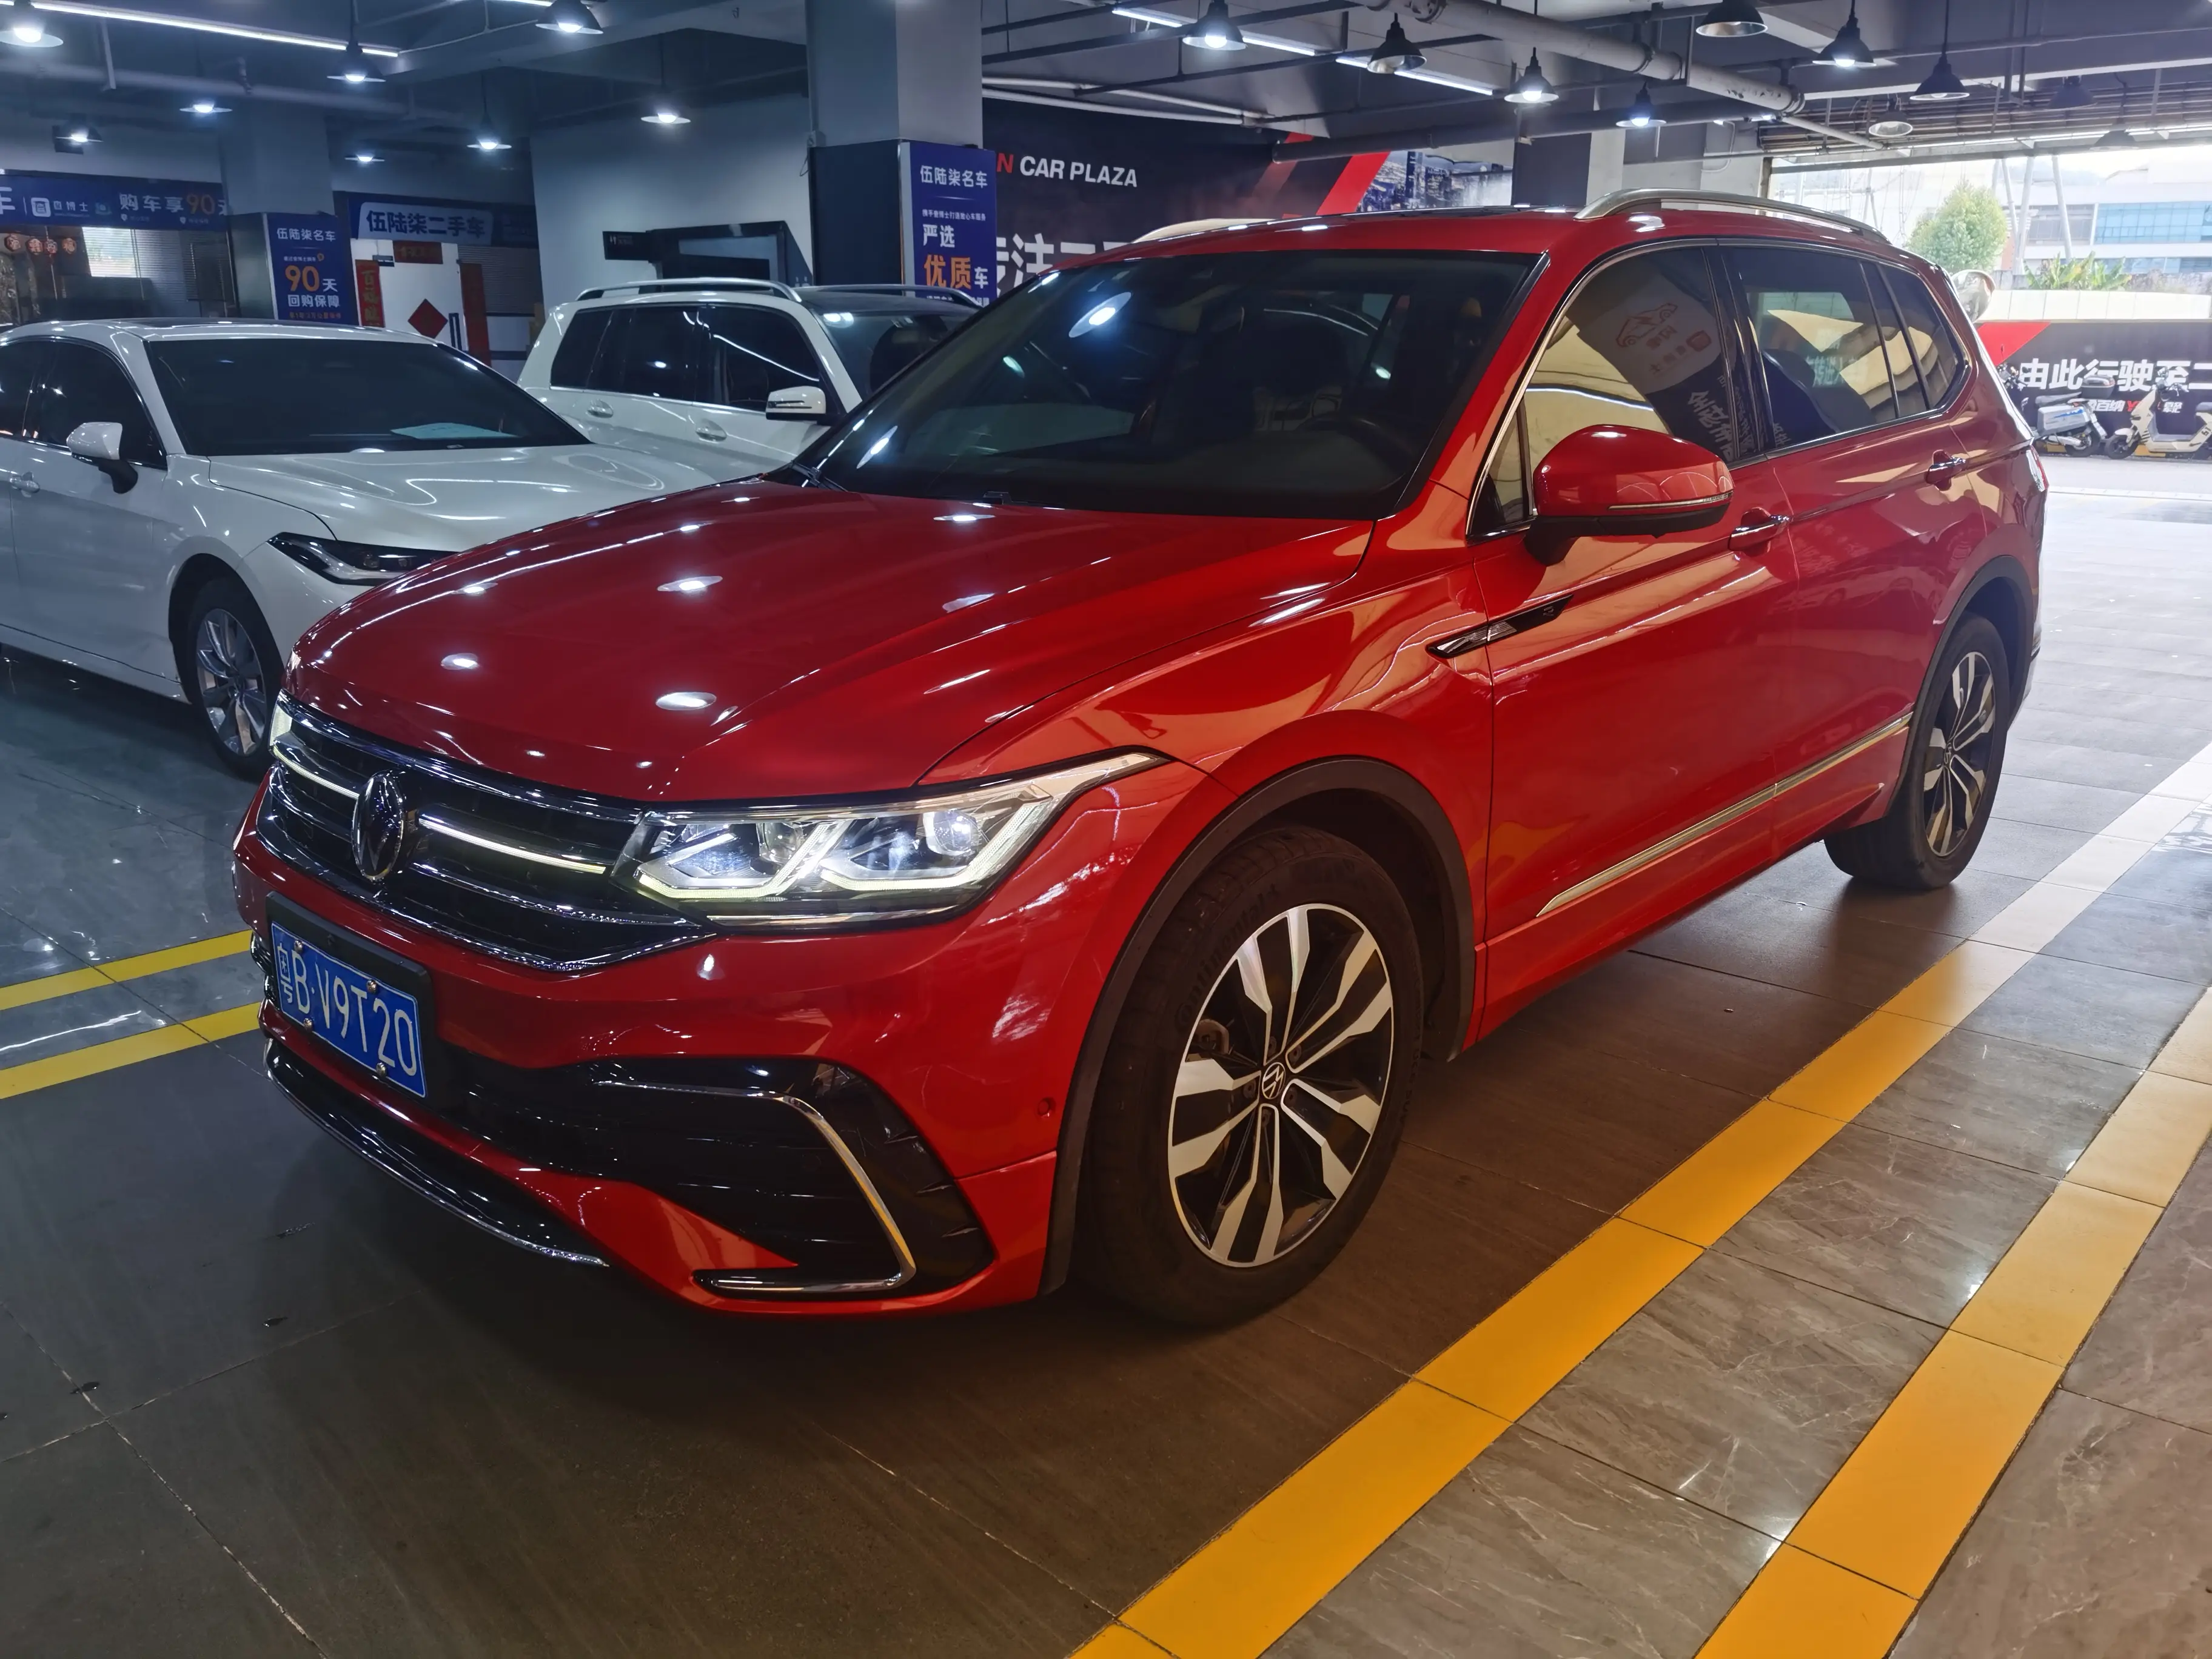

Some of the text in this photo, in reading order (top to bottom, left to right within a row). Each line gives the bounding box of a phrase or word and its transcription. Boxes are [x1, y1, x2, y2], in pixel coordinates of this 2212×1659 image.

[920, 164, 988, 189] 伍陆柒名车
[1020, 155, 1065, 179] CAR
[1070, 161, 1138, 188] PLAZA
[276, 227, 337, 242] 伍陆柒名车
[366, 210, 486, 240] 伍陆柒二手车
[922, 223, 956, 248] 严选
[923, 253, 990, 290] 优质车
[287, 294, 341, 308] 回购保障
